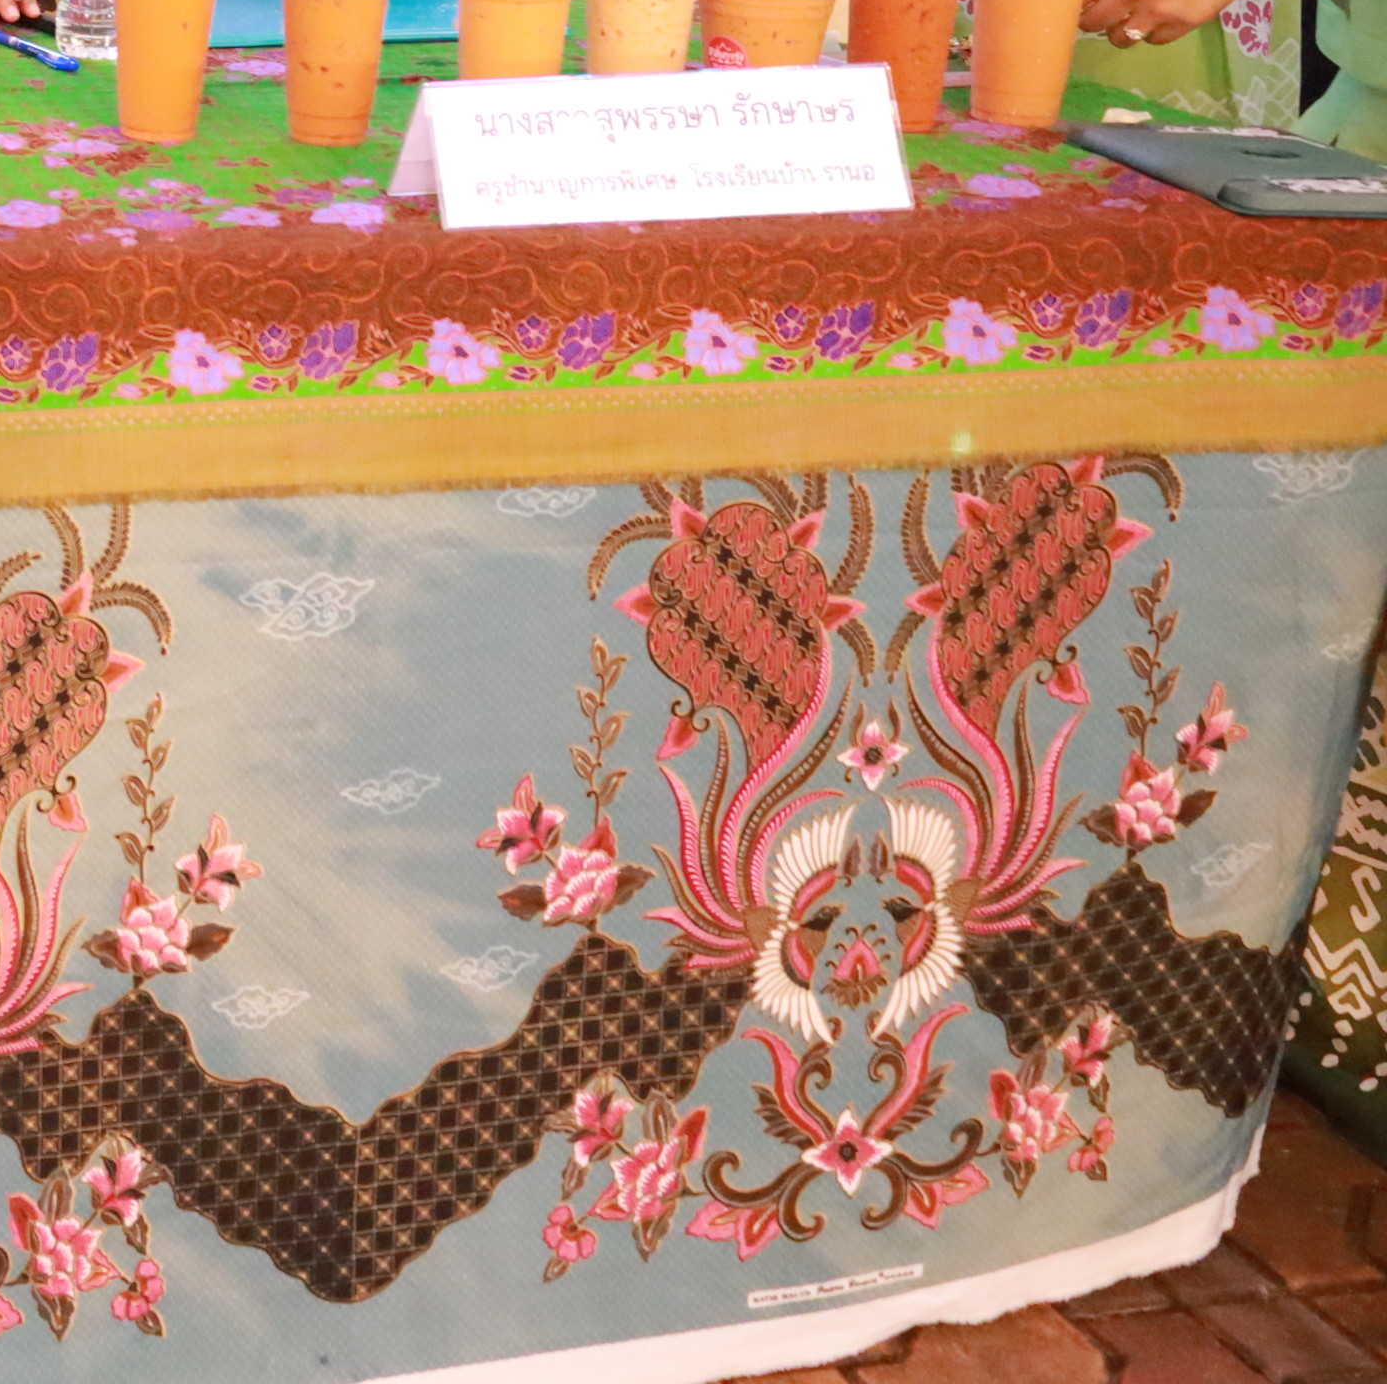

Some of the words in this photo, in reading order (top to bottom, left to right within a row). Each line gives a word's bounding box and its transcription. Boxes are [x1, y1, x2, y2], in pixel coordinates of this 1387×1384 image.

[475, 104, 719, 143] นางสสุพรรษา
